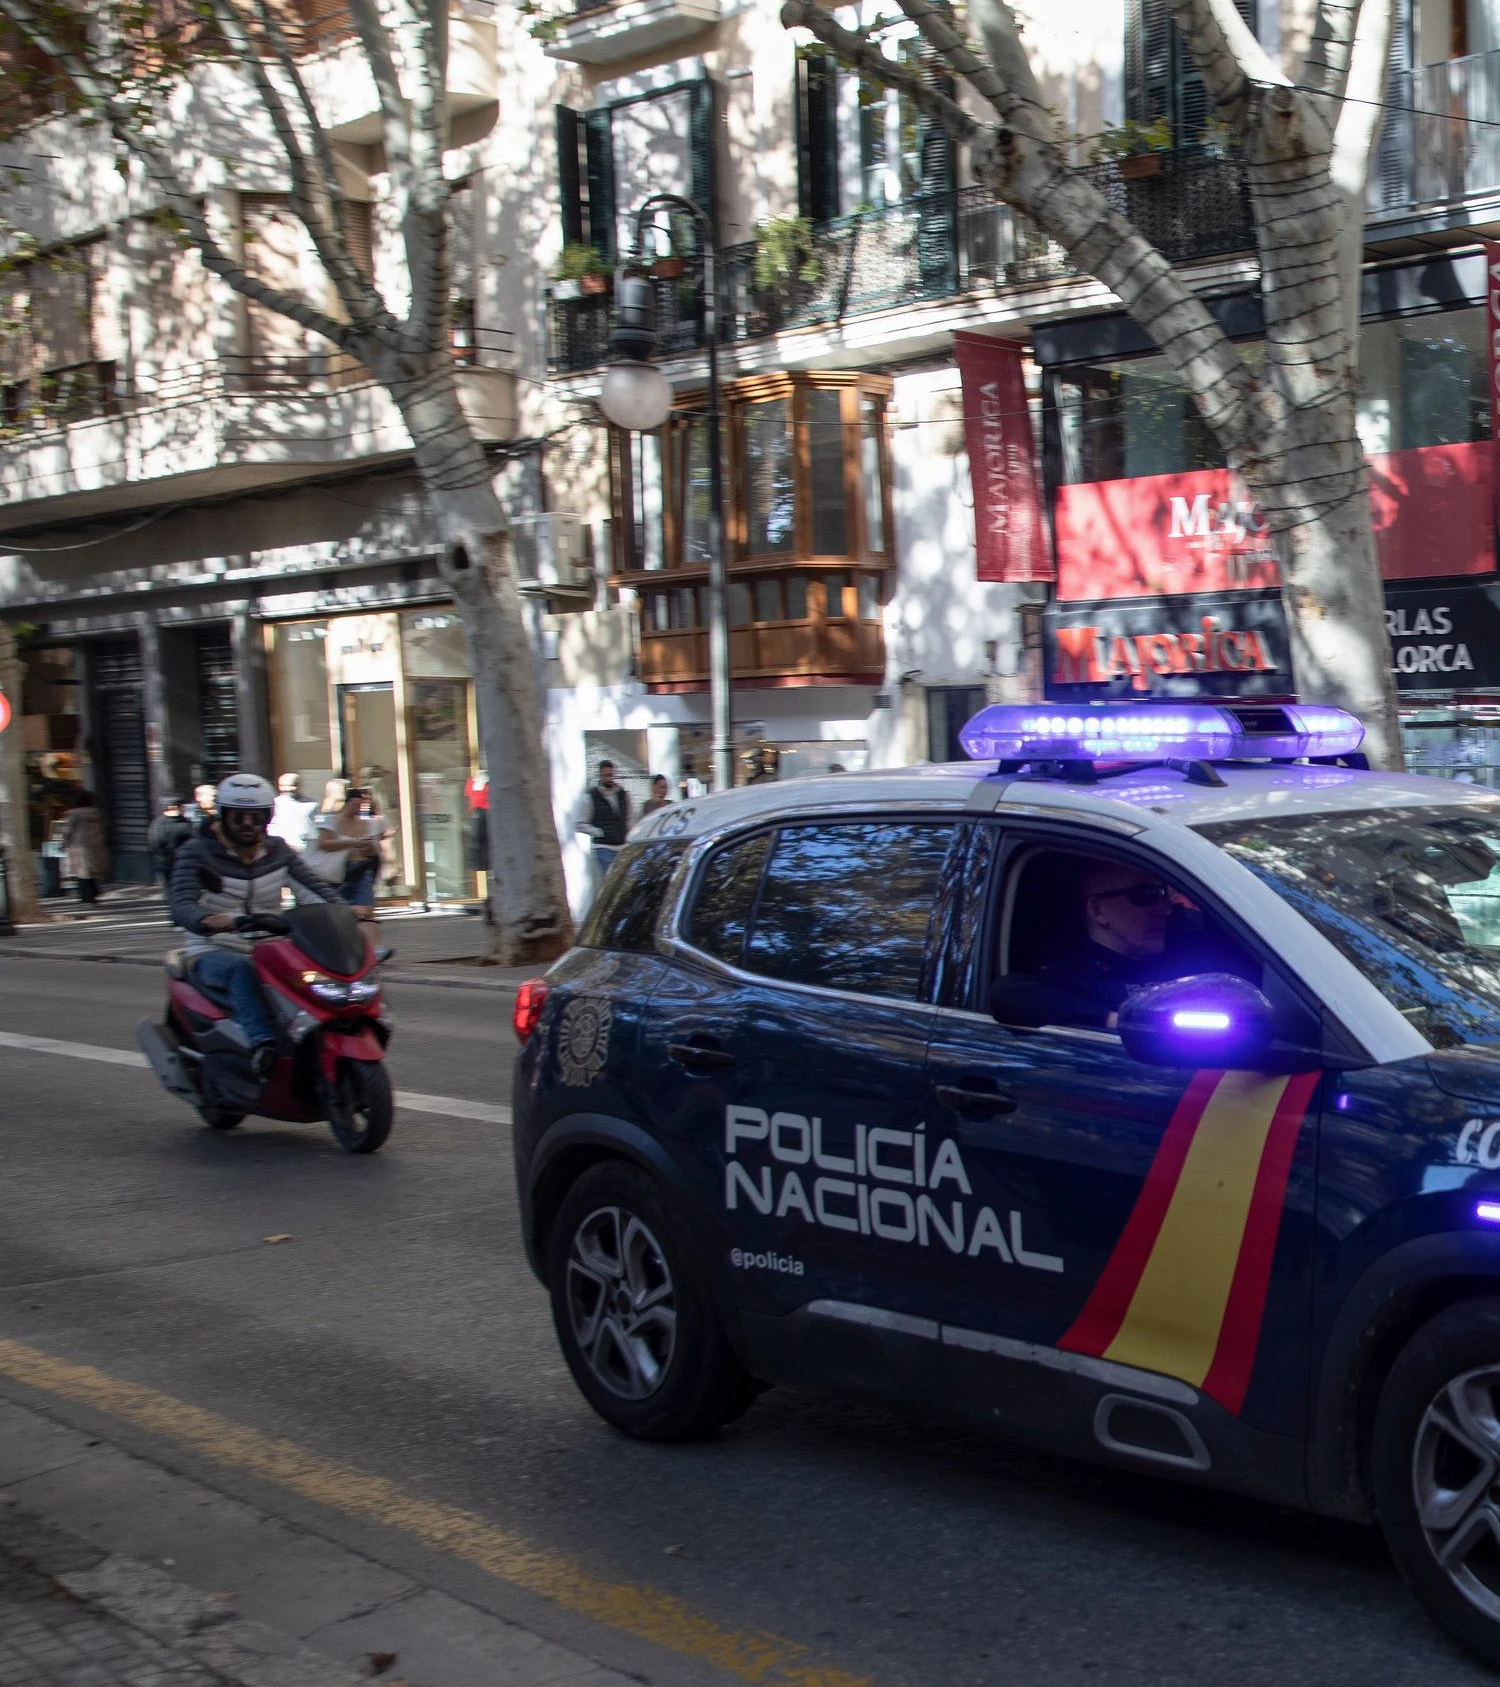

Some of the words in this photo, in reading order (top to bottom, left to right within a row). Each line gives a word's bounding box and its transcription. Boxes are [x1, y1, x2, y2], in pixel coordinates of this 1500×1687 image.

[980, 380, 1009, 535] MAJORICA
[724, 1103, 974, 1196] POLICÍA
[725, 1159, 1065, 1273] NACIONAL
[730, 1248, 805, 1277] @policia
